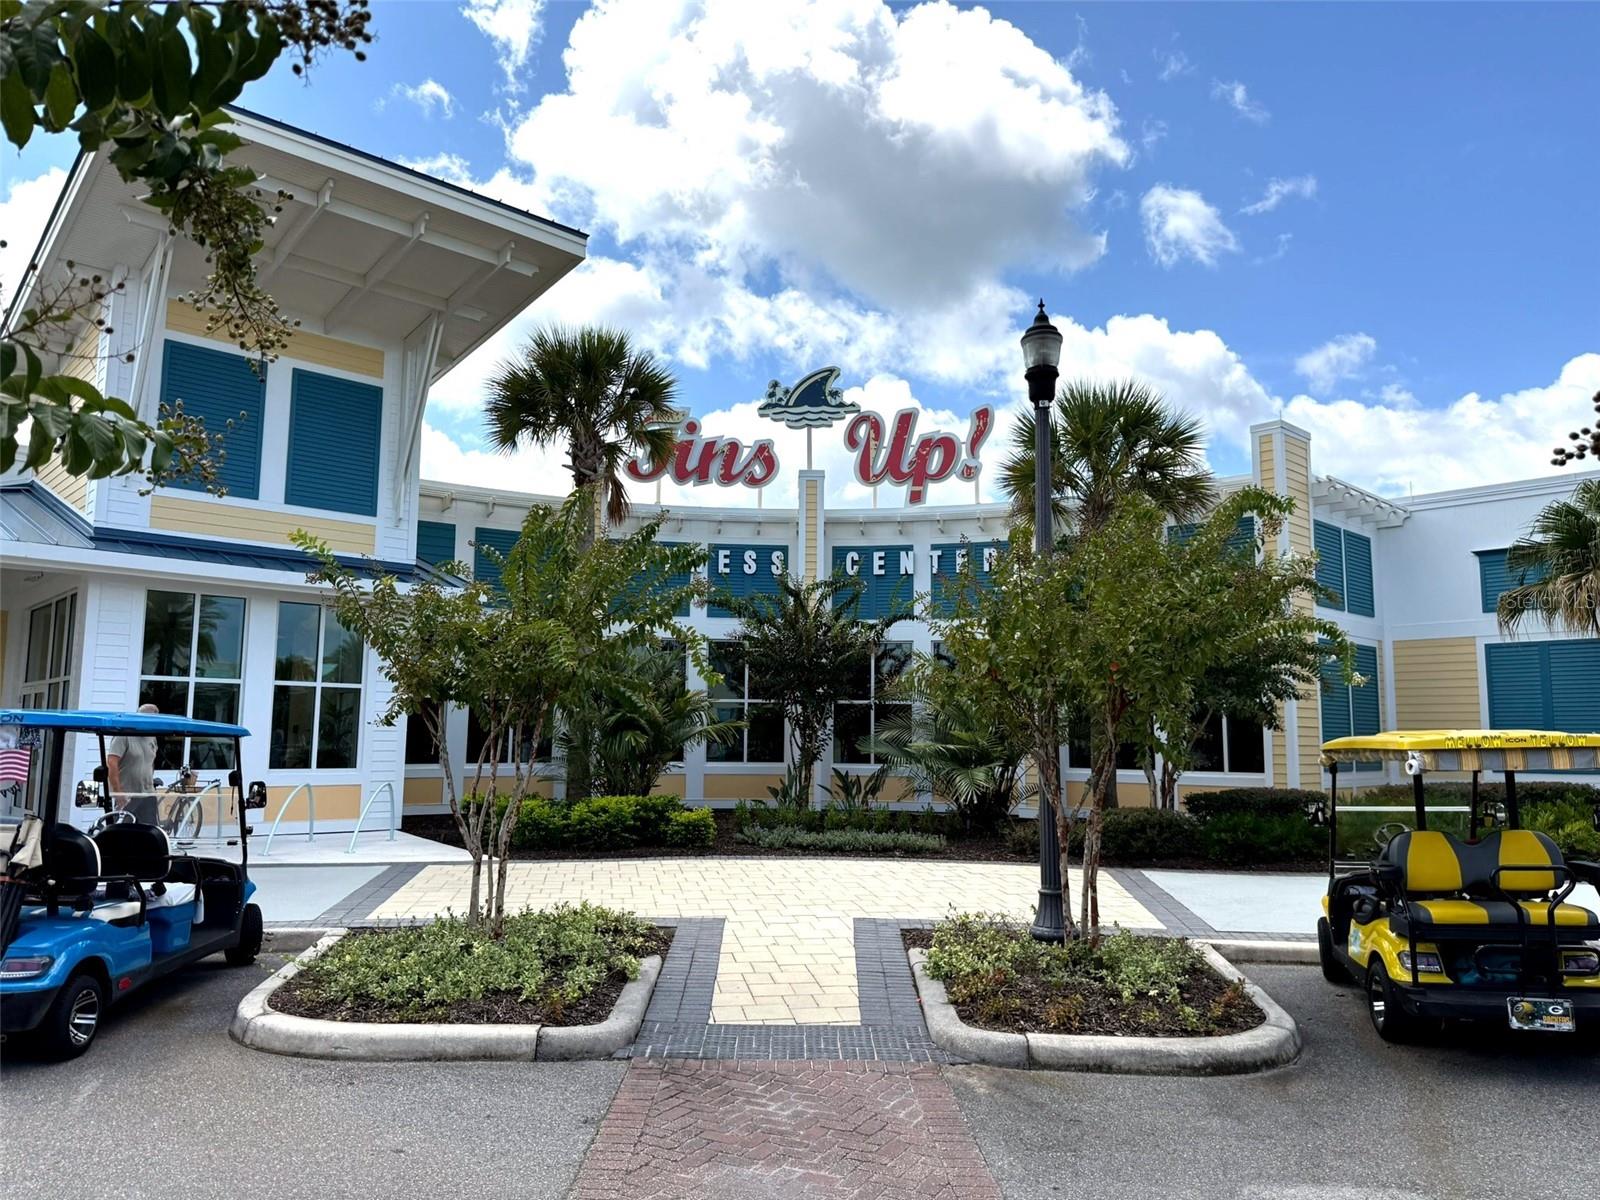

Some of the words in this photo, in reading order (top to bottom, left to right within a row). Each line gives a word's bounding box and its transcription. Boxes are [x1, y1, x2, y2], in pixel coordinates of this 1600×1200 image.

[844, 404, 994, 507] Up!
[1444, 735, 1502, 750] MELLOW
[1529, 734, 1588, 749] YELLOW
